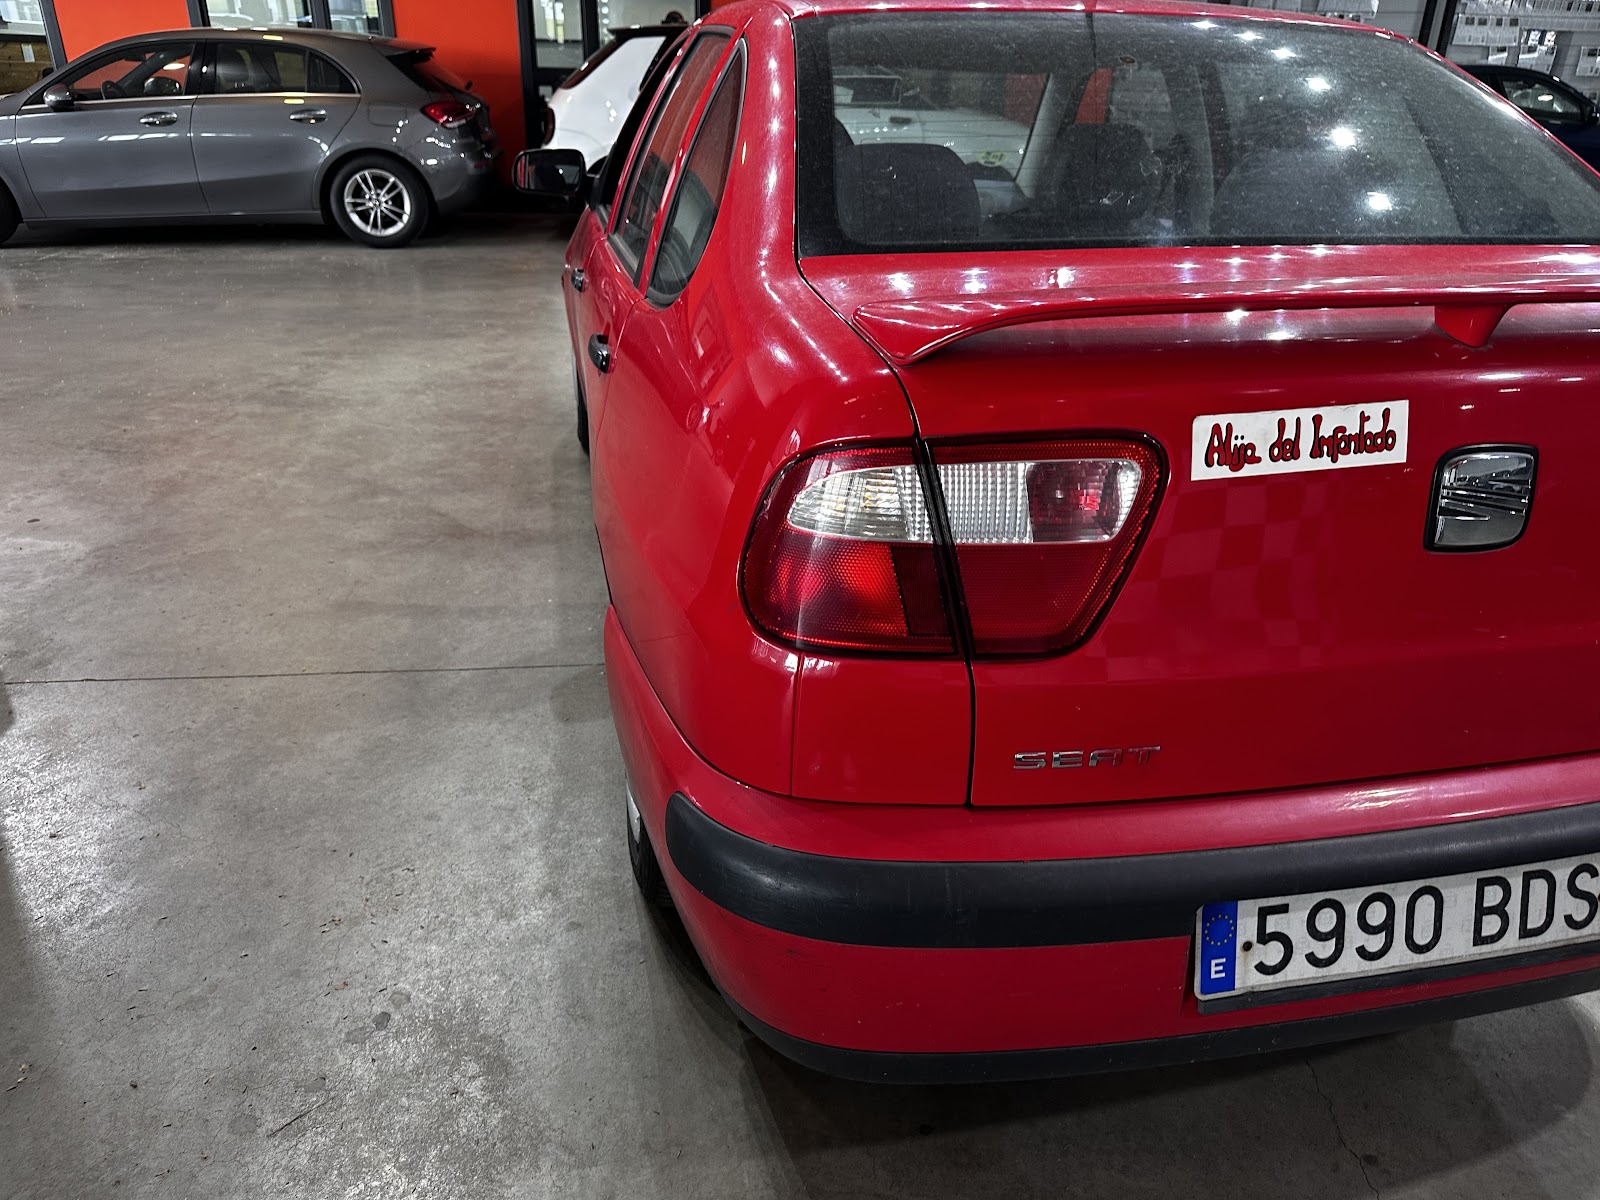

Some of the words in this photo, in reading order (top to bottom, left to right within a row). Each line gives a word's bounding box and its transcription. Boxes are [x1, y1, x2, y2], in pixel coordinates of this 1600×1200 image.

[1205, 423, 1262, 472] Alija
[1269, 417, 1301, 462] del
[1310, 408, 1396, 463] Infantado
[1014, 746, 1160, 769] SEAT
[1254, 885, 1444, 976] 5990
[1473, 863, 1600, 948] BDS
[1211, 958, 1226, 979] E
